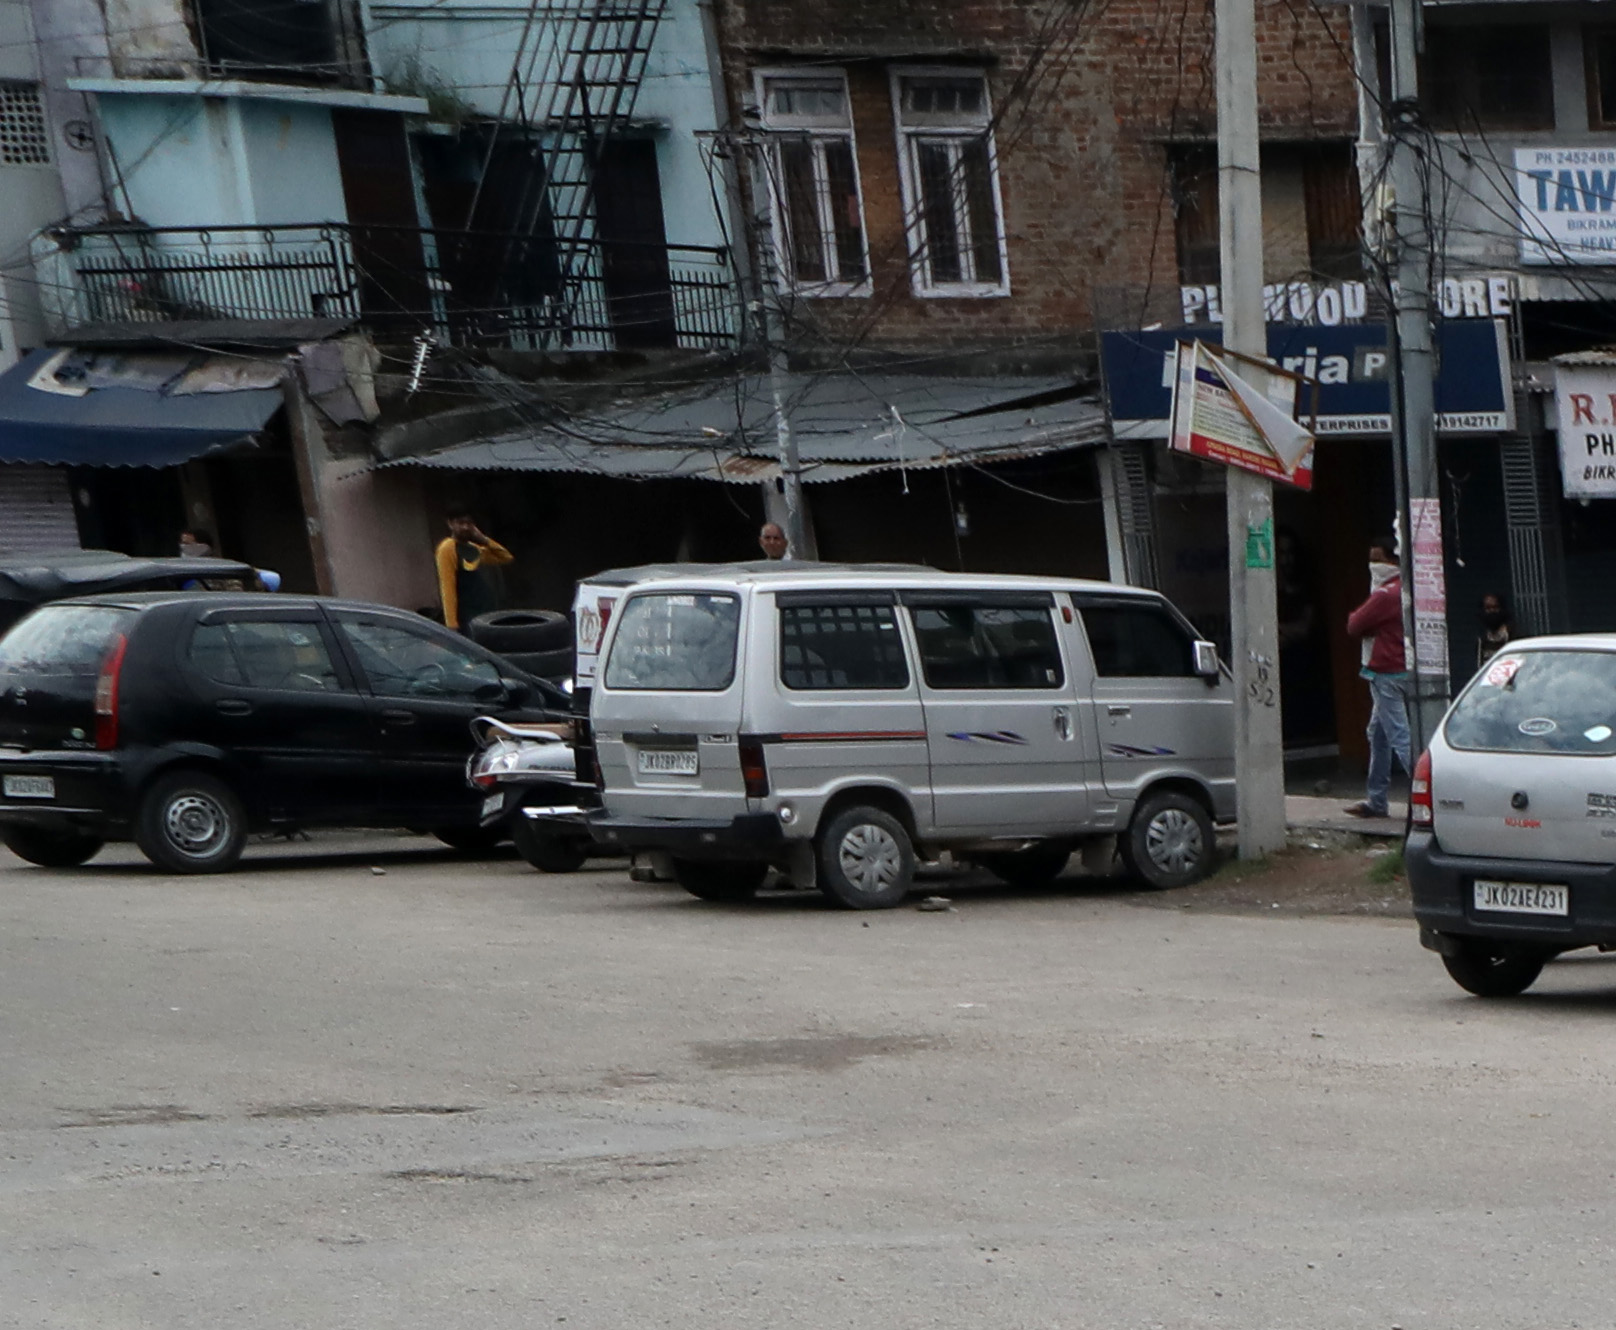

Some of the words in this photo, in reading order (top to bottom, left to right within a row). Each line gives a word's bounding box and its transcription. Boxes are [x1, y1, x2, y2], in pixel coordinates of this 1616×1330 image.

[1567, 218, 1616, 232] BIKRAM
[1181, 281, 1367, 327] PLWOOD
[1300, 418, 1389, 431] NTERPRISES
